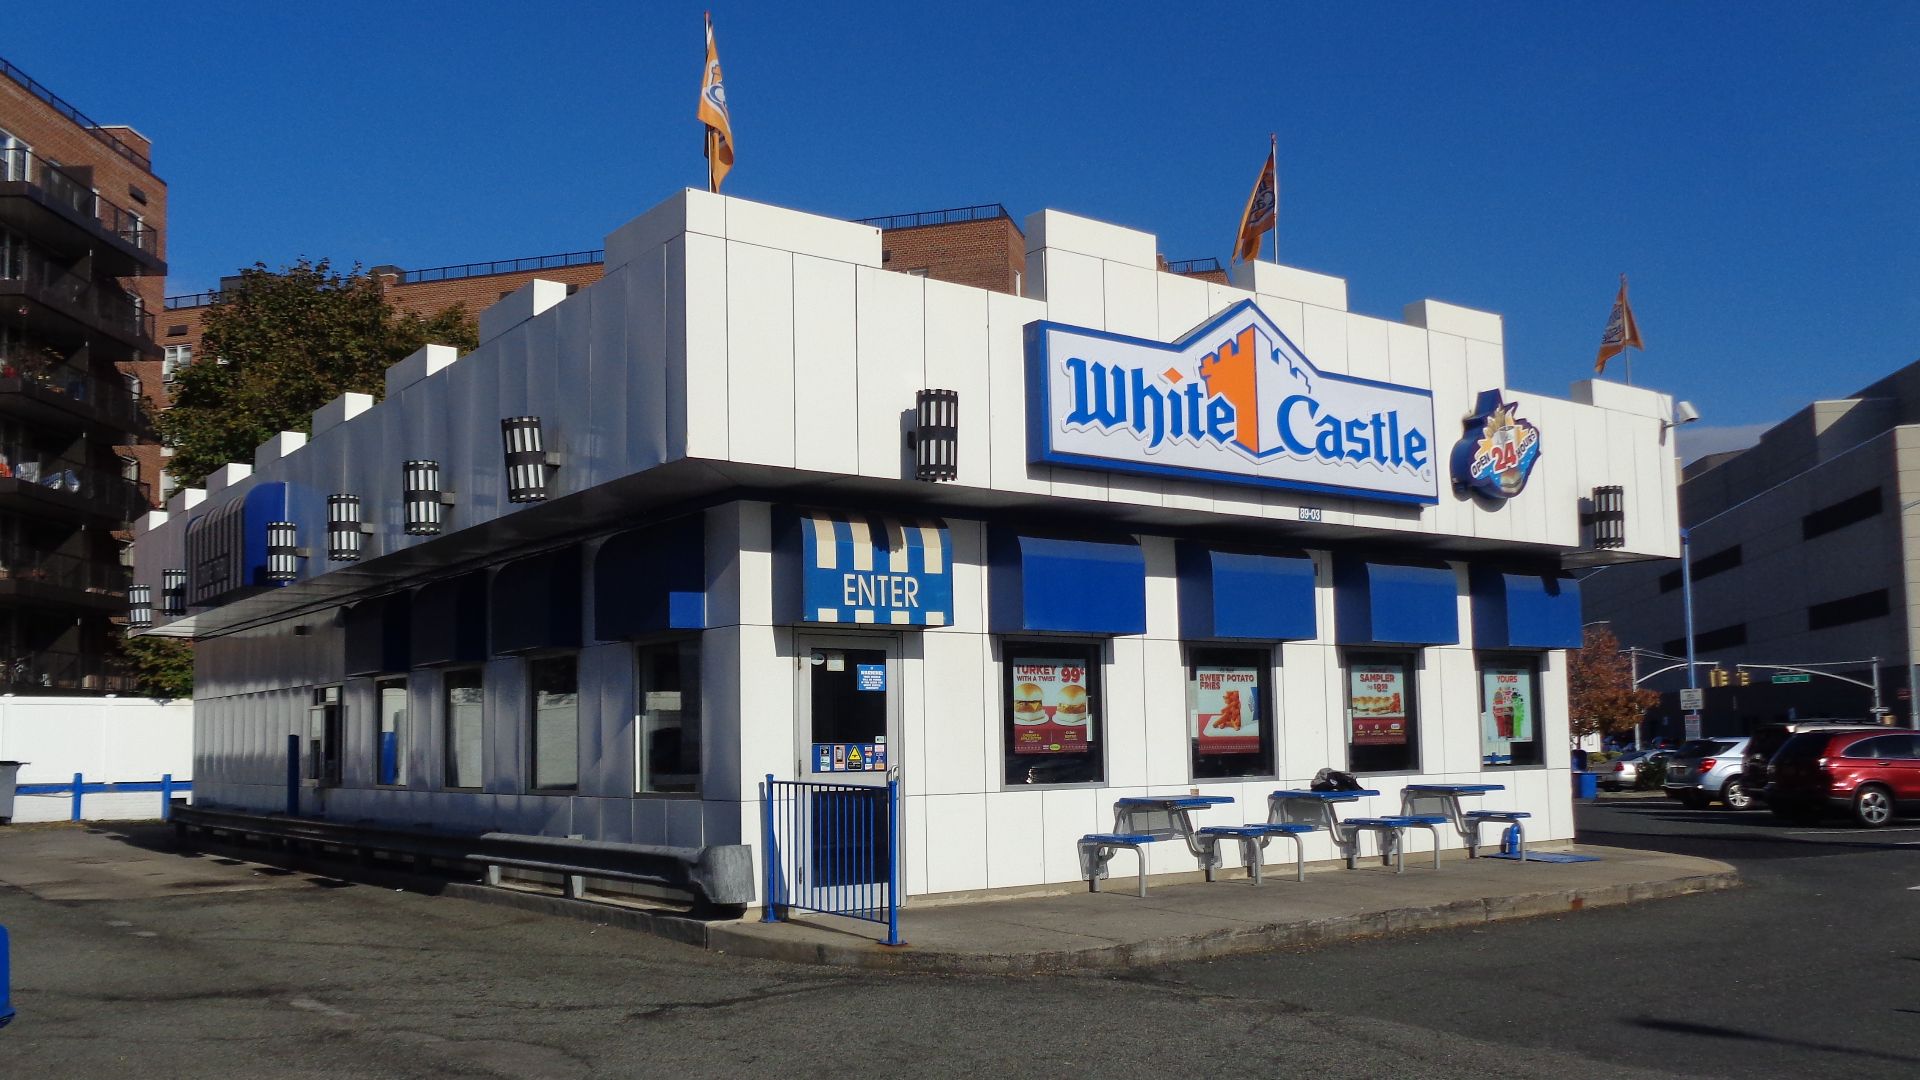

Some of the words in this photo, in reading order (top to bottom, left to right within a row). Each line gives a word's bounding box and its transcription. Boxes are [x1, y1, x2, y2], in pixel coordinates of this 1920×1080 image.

[1066, 357, 1235, 448] White
[1276, 394, 1428, 470] Castle
[1471, 454, 1491, 476] OPEN
[1491, 441, 1517, 472] 24
[1516, 429, 1537, 457] HOURS
[1300, 507, 1321, 521] 89-03
[843, 573, 919, 608] ENTER
[1016, 664, 1057, 675] TURKEY
[1199, 673, 1225, 683] SWEET
[1226, 674, 1255, 683] POTATO
[1360, 673, 1395, 683] SAMPLER
[1496, 675, 1518, 683] YOURS
[1200, 682, 1221, 690] FRIES
